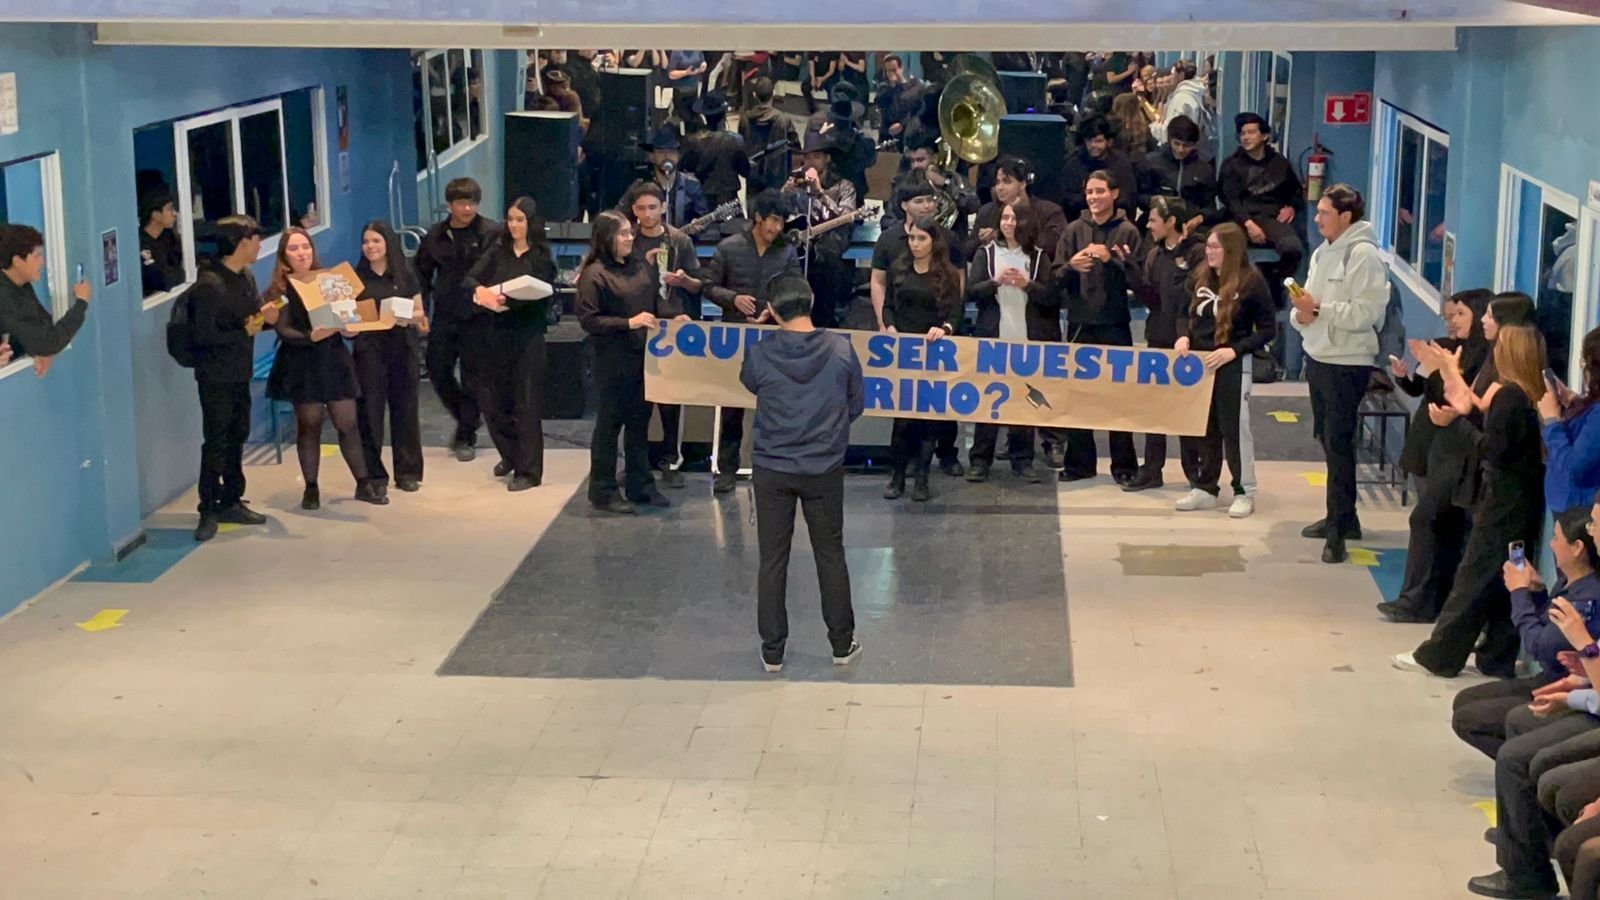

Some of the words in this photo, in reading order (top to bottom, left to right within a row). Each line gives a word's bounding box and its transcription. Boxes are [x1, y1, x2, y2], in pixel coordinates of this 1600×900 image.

[867, 335, 958, 372] SER
[976, 340, 1204, 387] NUESTRO
[862, 376, 1010, 420] RINO?
